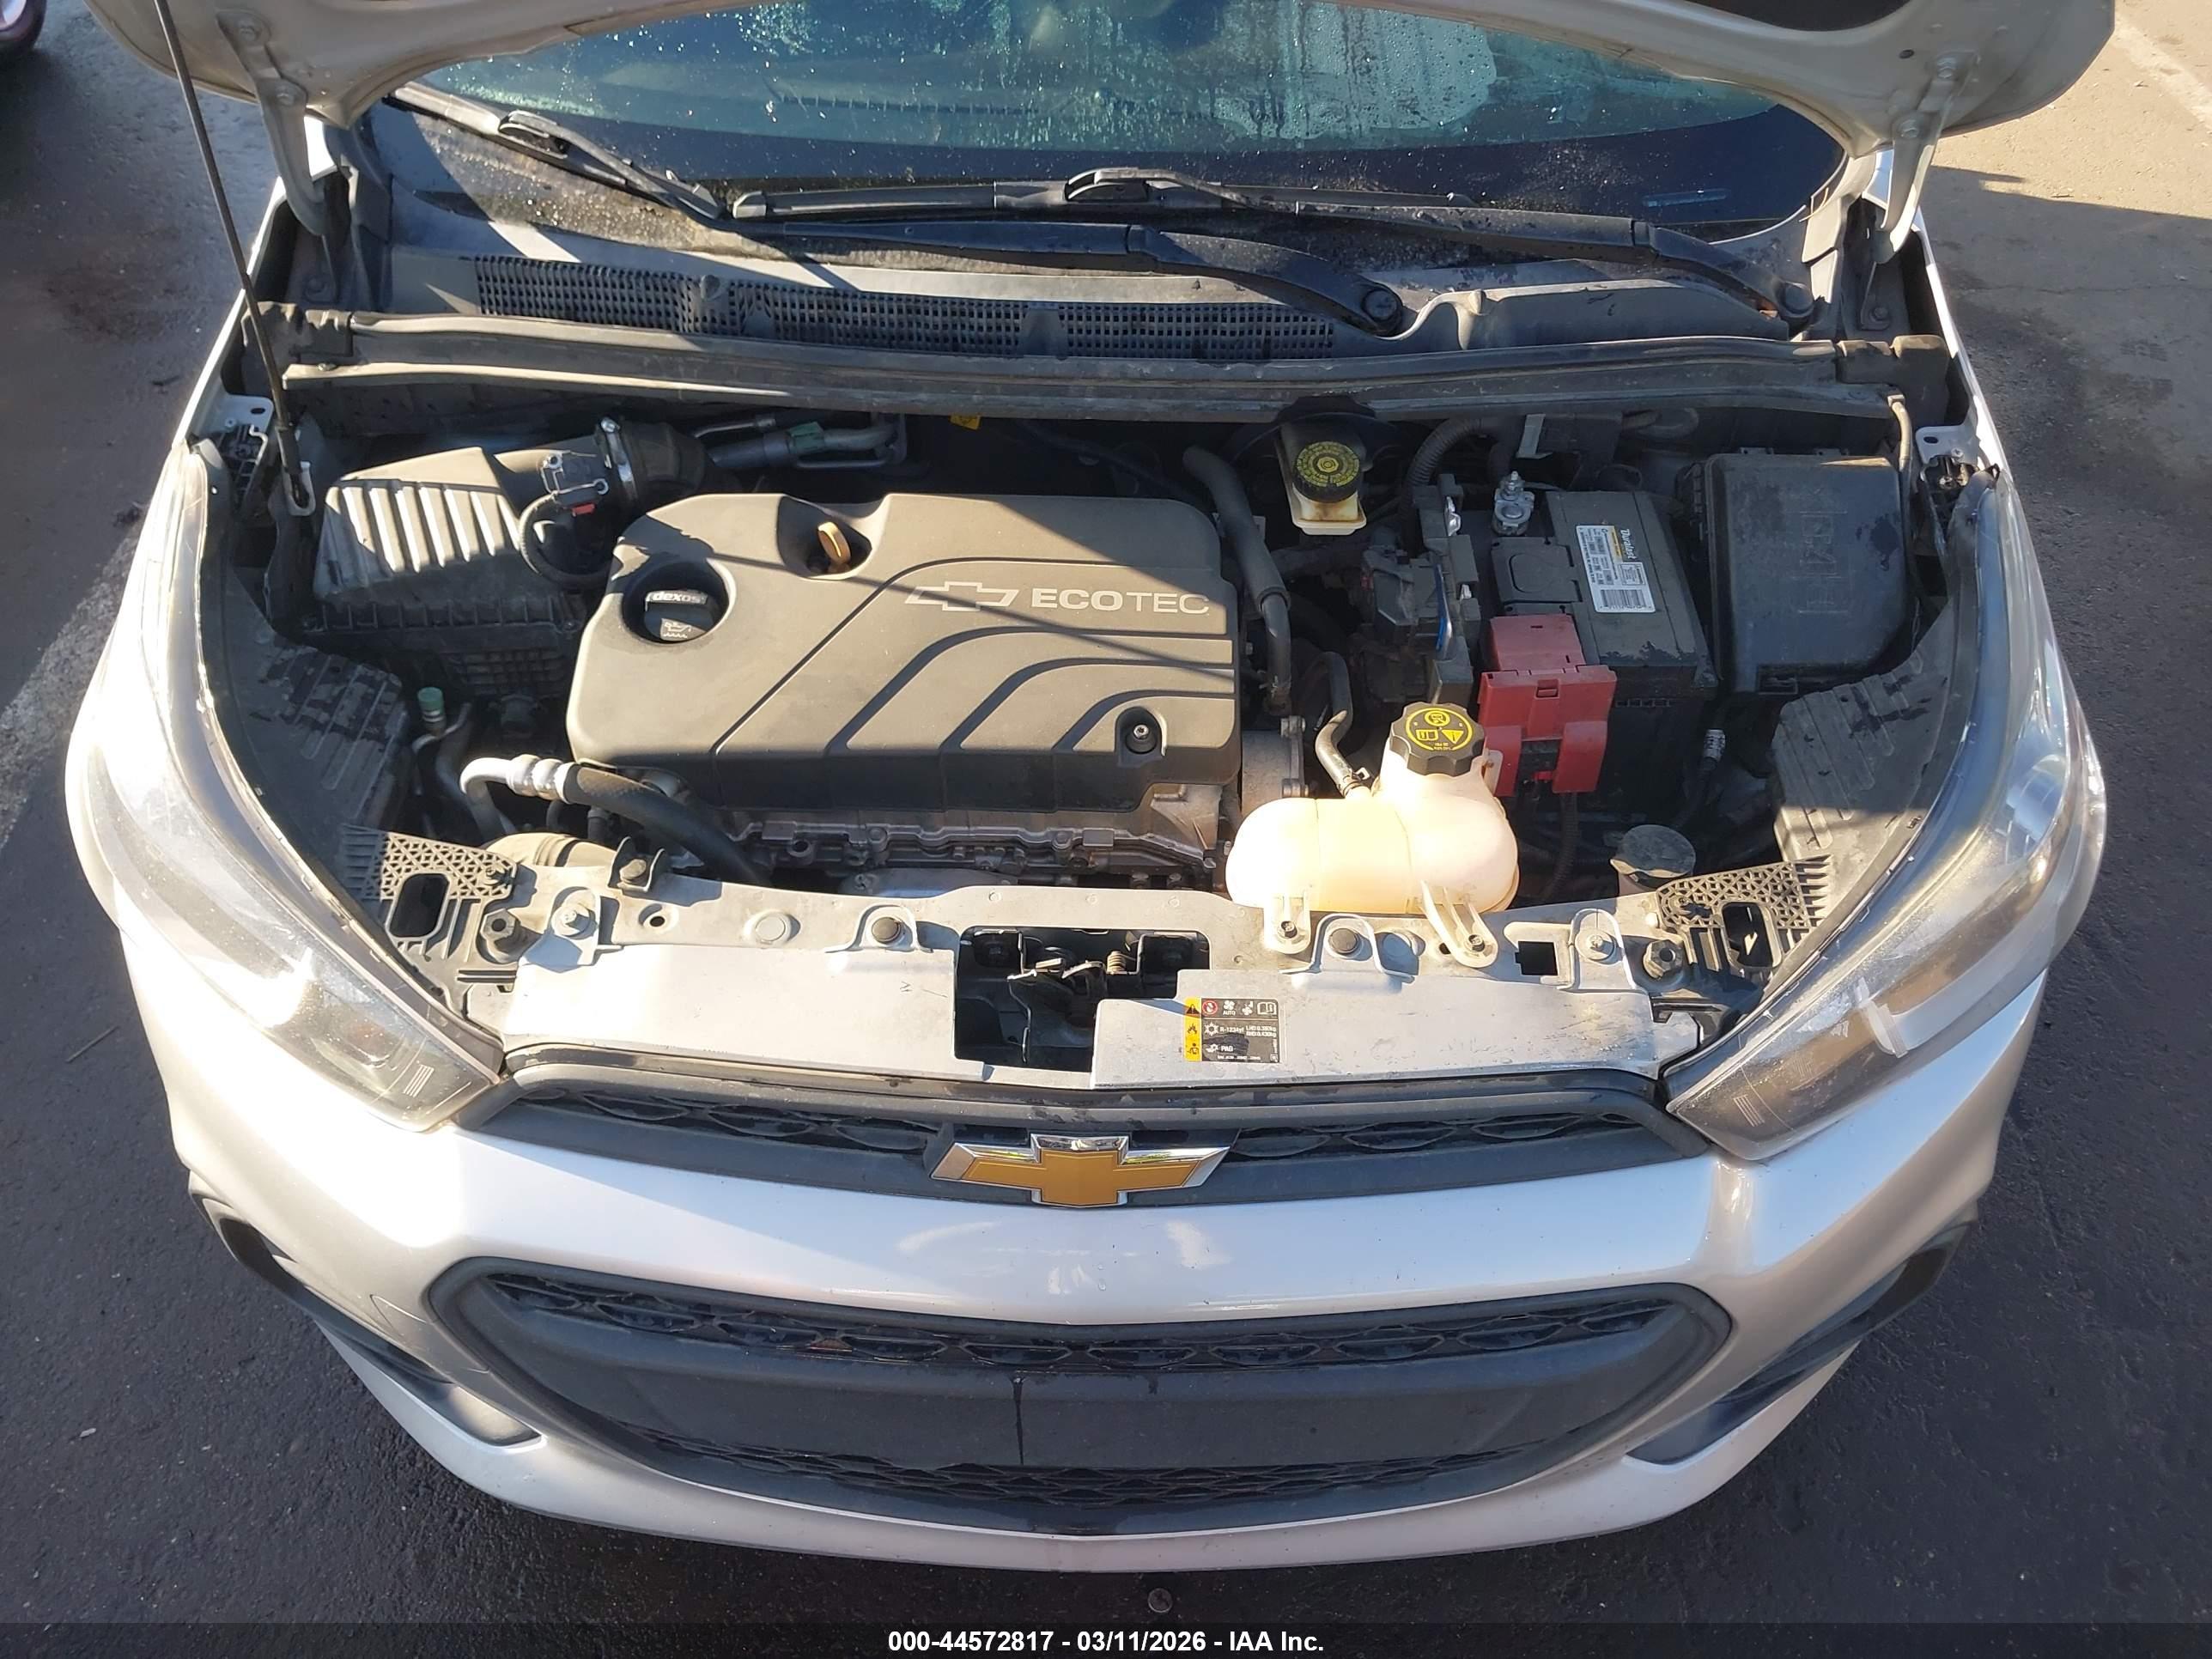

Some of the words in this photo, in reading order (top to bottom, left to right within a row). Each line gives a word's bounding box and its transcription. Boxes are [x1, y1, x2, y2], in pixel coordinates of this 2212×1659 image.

[1620, 528, 1638, 560] Duralast
[652, 592, 701, 604] dexos
[1031, 587, 1210, 615] ECOTEC
